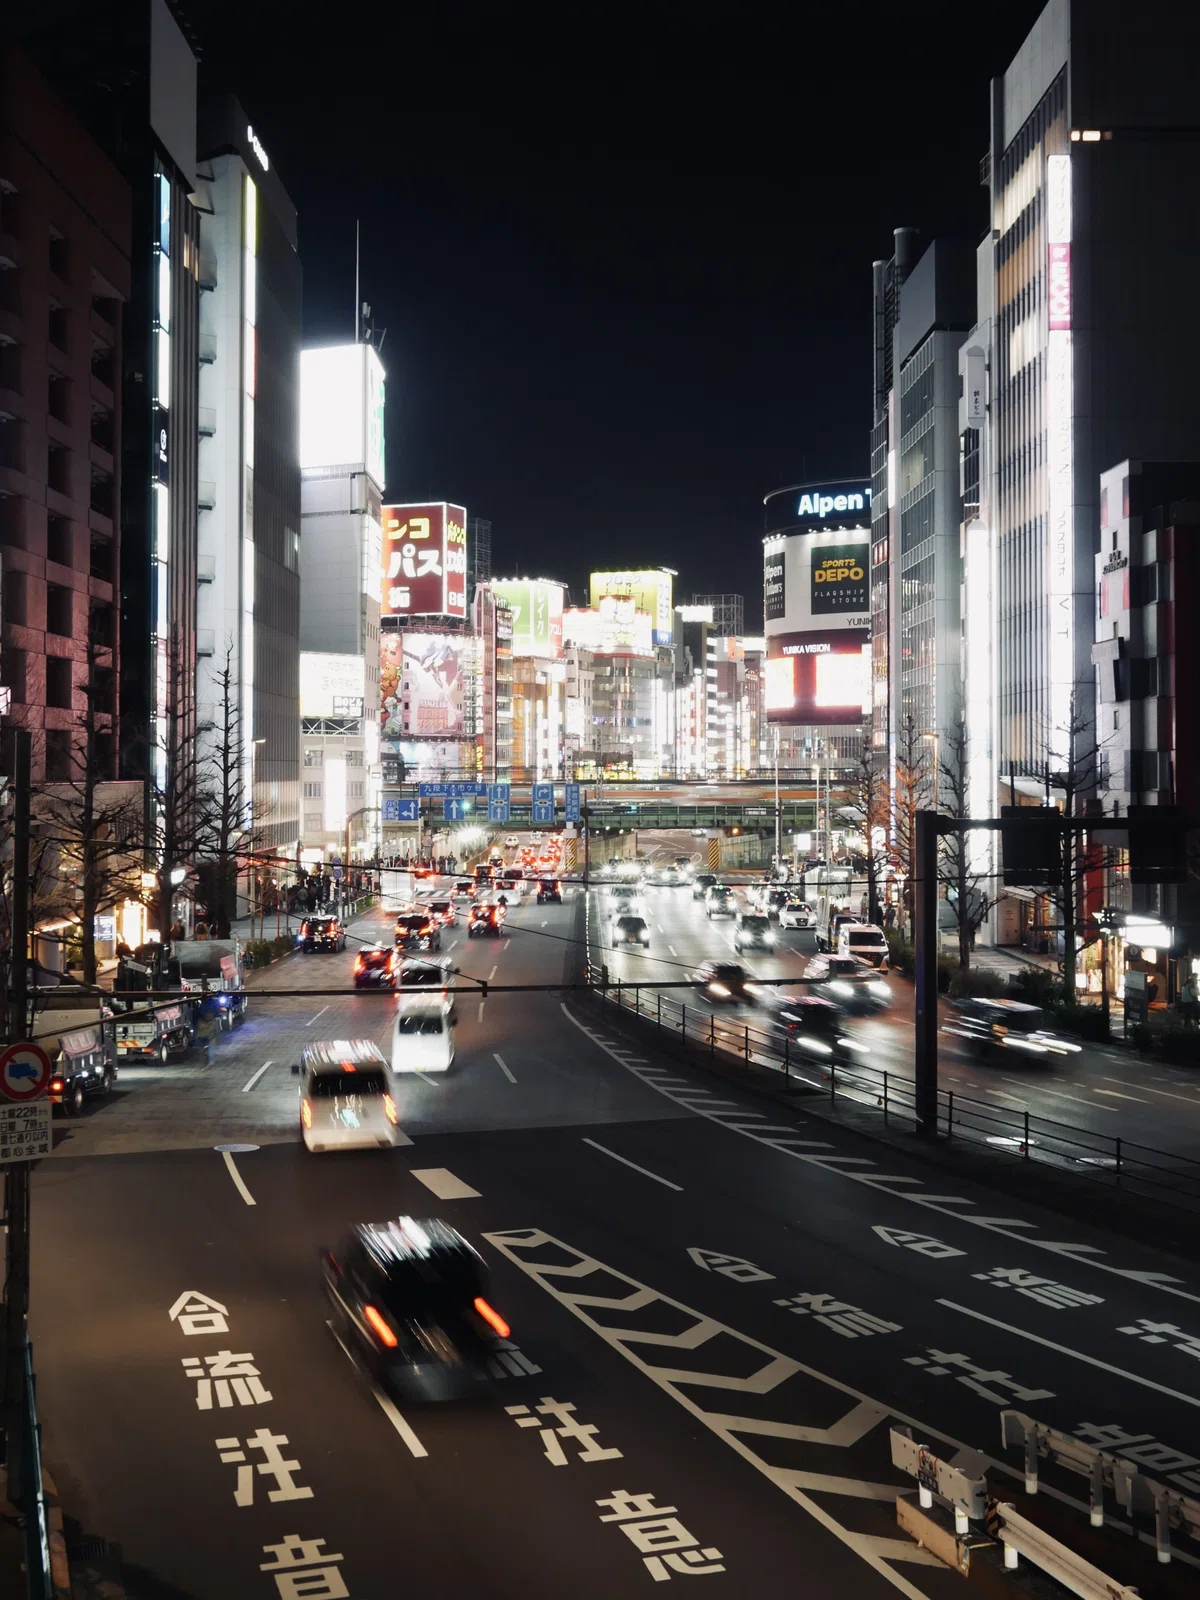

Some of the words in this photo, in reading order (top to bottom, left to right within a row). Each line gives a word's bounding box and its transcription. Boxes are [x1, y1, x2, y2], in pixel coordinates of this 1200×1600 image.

[798, 493, 863, 517] Alpen
[822, 558, 855, 568] SPORTS
[815, 567, 864, 583] DEPO
[814, 589, 864, 597] FLAGSHIP
[782, 645, 804, 655] YUNIKA
[805, 643, 830, 653] VISION
